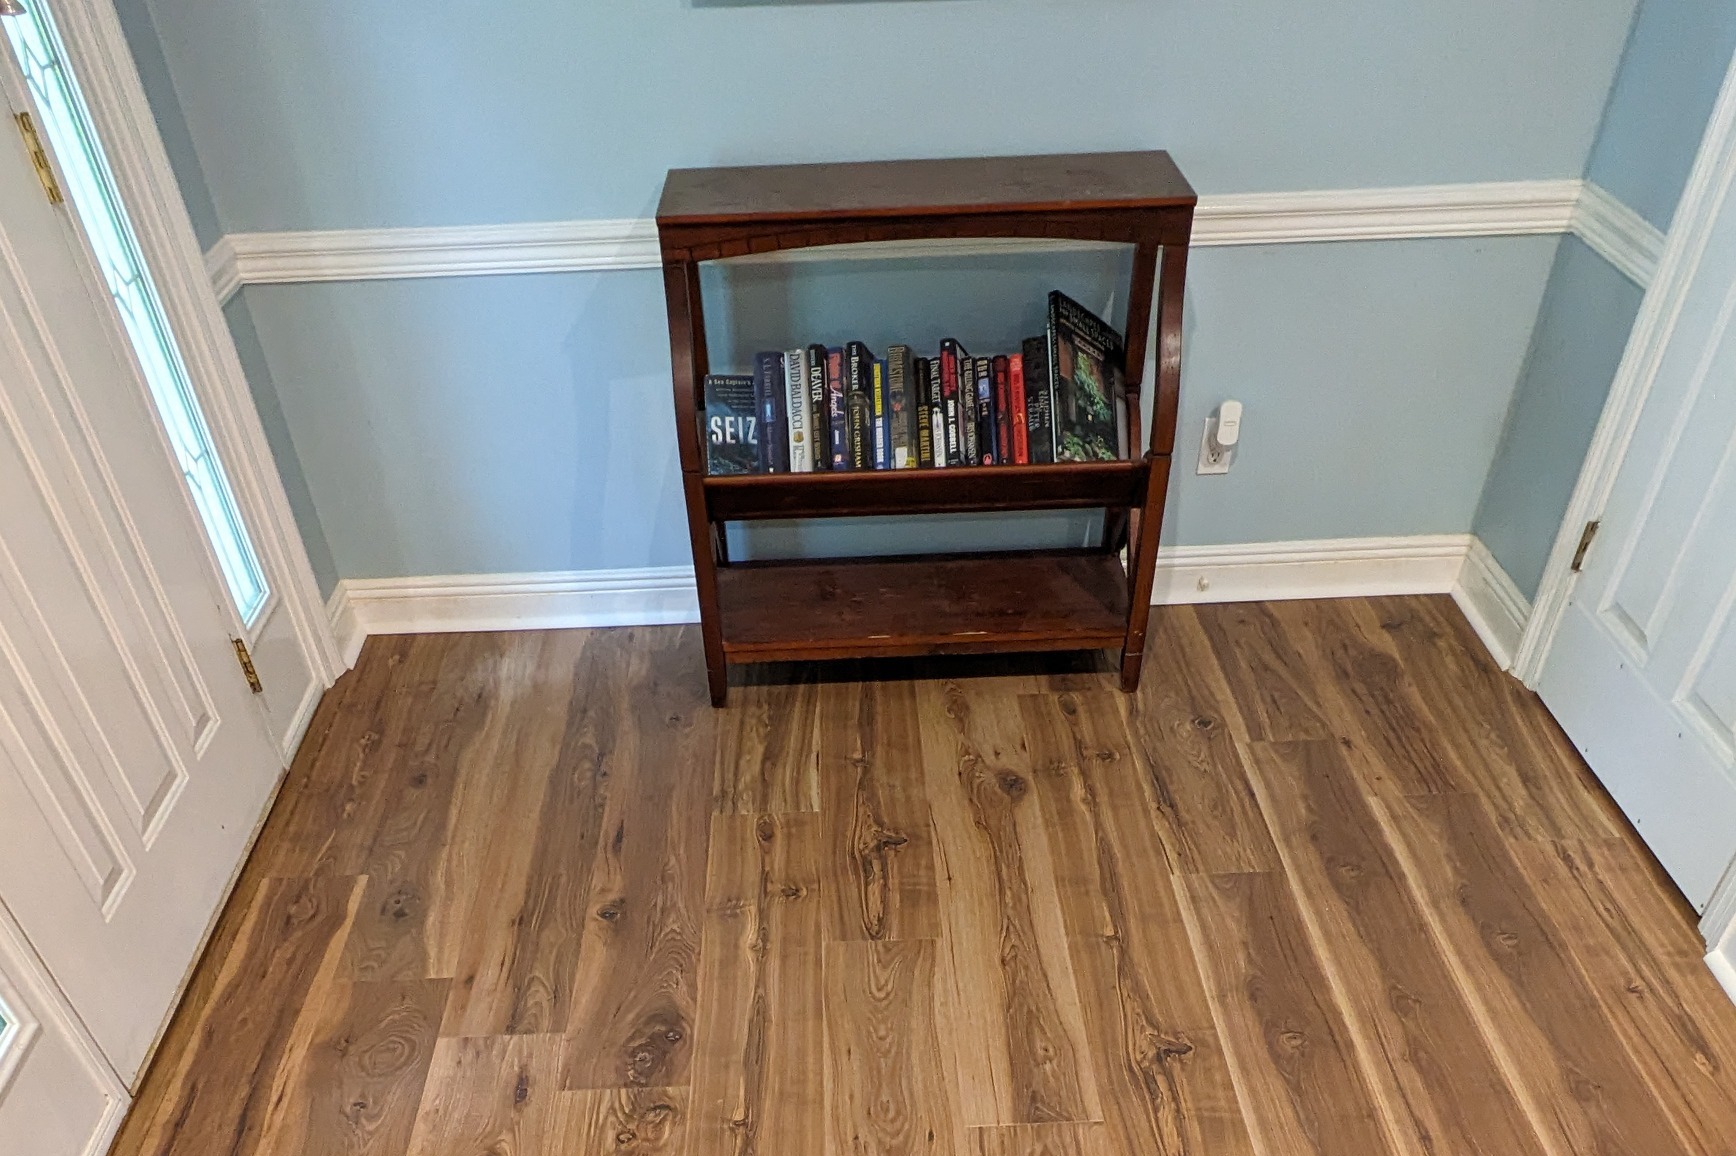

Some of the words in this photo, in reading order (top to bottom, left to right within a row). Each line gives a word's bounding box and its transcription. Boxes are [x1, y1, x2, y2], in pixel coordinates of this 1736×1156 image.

[789, 354, 801, 382] DAVID
[850, 356, 860, 391] BROKER
[930, 360, 940, 379] FINAL
[964, 358, 972, 370] THE
[810, 367, 823, 403] DEAVER
[930, 379, 941, 403] TARGET
[964, 370, 974, 392] KILLING
[791, 383, 803, 430] BALDACCI
[829, 385, 844, 418] Angels
[947, 399, 955, 416] JOHN
[852, 406, 861, 429] JOHN
[917, 405, 929, 428] STEVE
[853, 430, 862, 468] GRISHAM
